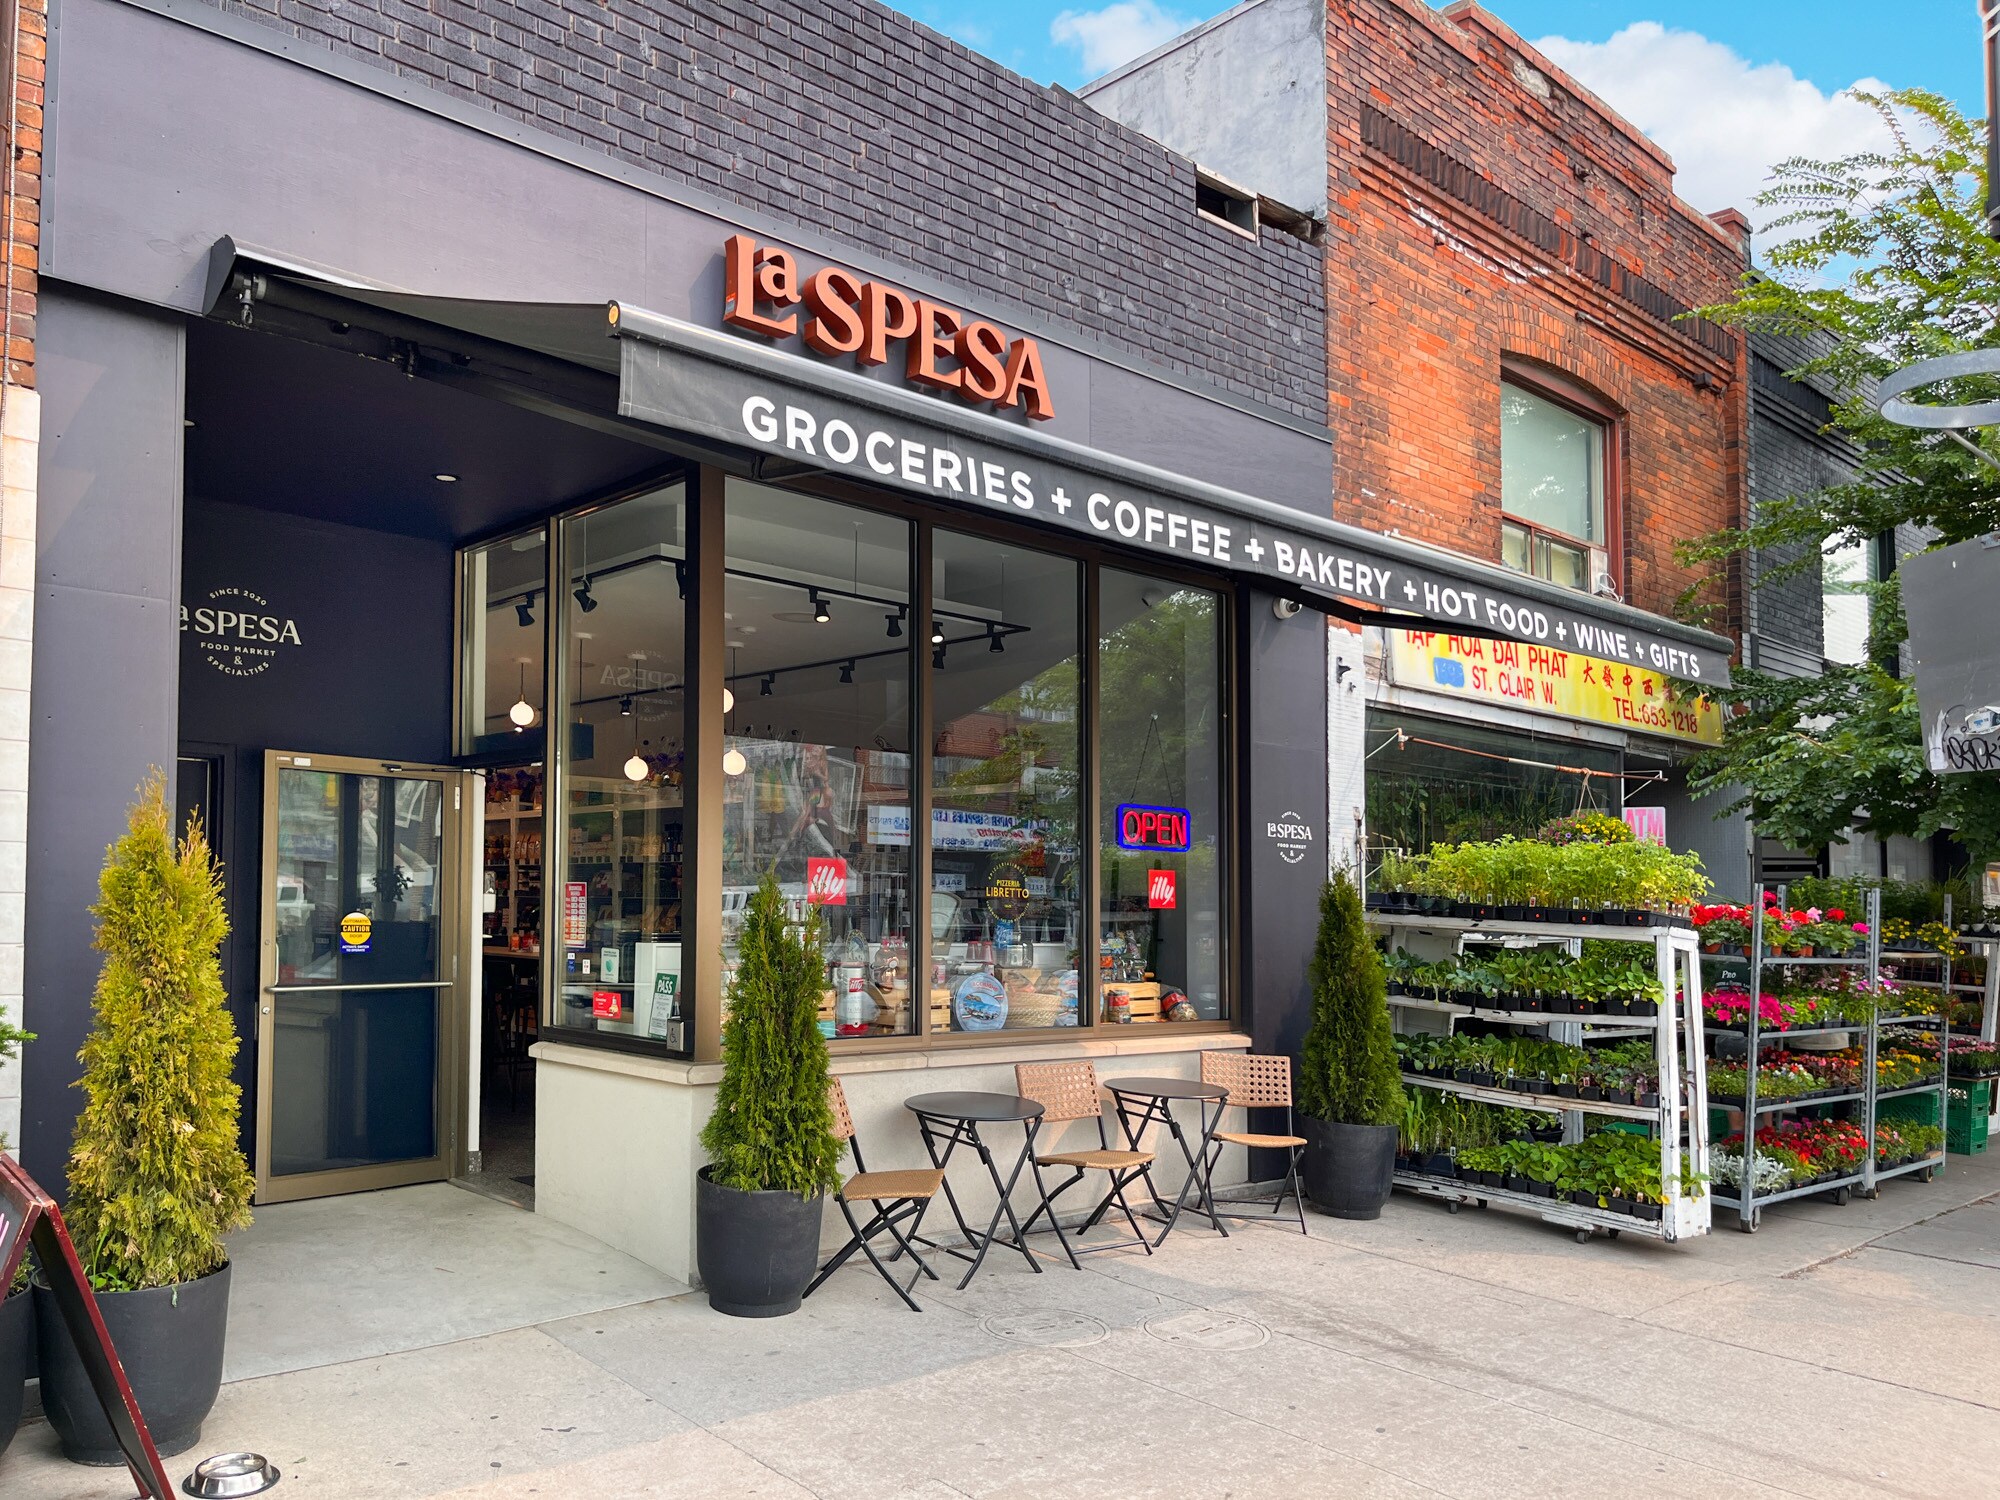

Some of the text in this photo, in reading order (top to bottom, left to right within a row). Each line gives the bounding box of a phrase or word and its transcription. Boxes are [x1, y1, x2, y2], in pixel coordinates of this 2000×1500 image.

[724, 234, 1055, 422] La SPESA
[742, 396, 1034, 510] GROCERIES
[1087, 493, 1231, 562] COFFEE
[1274, 540, 1392, 600] BAKERY
[1424, 582, 1478, 619] HOT
[1485, 598, 1548, 639] FOOD
[1573, 622, 1629, 659] WINE
[1650, 643, 1700, 678] GIFTS
[209, 588, 267, 606] SINCE 2020
[194, 608, 302, 646] SPESA
[201, 642, 276, 657] FOOD MARKET
[206, 655, 270, 676] SPECIALTIES
[233, 655, 243, 666] &
[1472, 665, 1493, 692] ST.
[1499, 672, 1535, 701] CLAIR
[1541, 680, 1558, 705] W.
[1122, 810, 1187, 846] OPEN
[1267, 822, 1313, 841] La SPESA
[1625, 808, 1664, 838] ATM
[810, 866, 845, 900] illy
[986, 887, 1029, 899] LIBRETTO
[997, 880, 1020, 888] PIZZERIA
[1151, 876, 1174, 905] illy
[656, 979, 673, 994] PASS
[850, 980, 863, 990] illy
